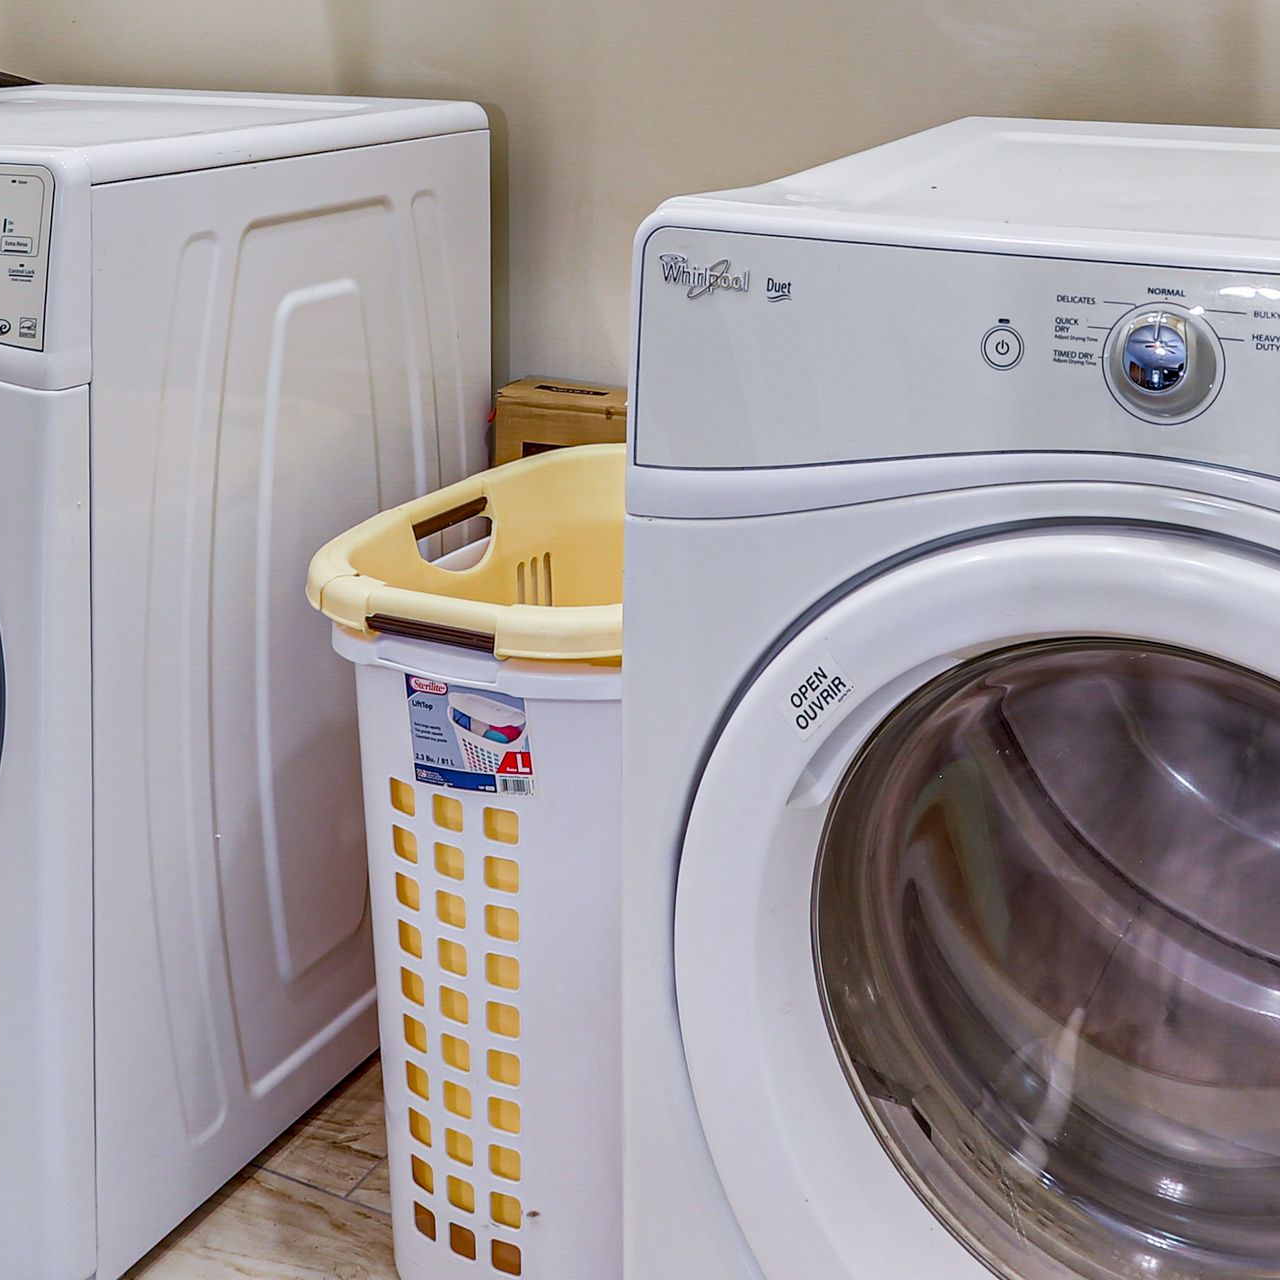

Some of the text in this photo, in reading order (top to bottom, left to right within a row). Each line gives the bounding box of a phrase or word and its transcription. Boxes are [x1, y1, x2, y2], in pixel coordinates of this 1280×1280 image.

[661, 260, 792, 295] Whirlpool Duet
[1147, 287, 1186, 297] NORMAL
[1056, 294, 1096, 305] DELICATES
[1055, 317, 1079, 326] QUICK
[1054, 325, 1070, 333] DRY
[1251, 334, 1280, 343] HEAVY
[1255, 343, 1280, 352] DUTY
[1053, 350, 1094, 360] TIMED DRY
[414, 679, 442, 692] Sterilite
[790, 666, 828, 708] OPEN
[796, 676, 847, 730] OUVRIR
[516, 753, 530, 773] L
